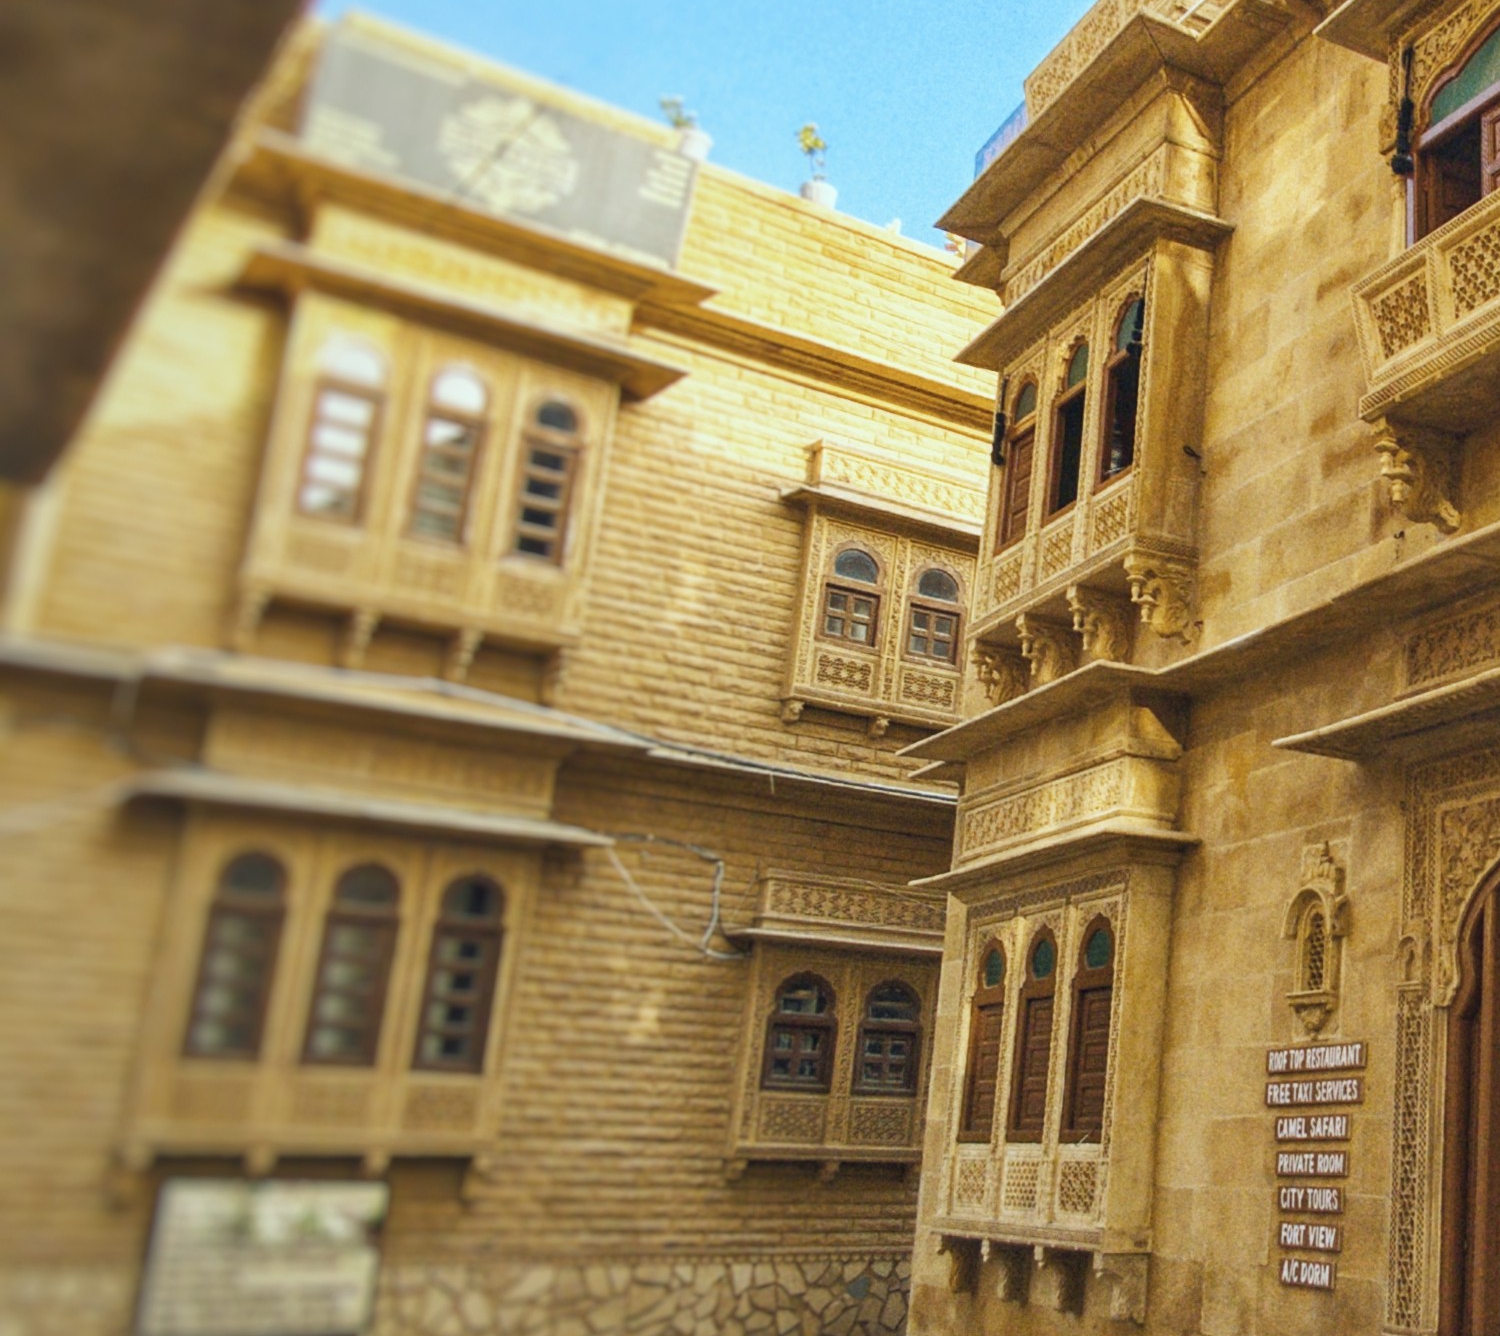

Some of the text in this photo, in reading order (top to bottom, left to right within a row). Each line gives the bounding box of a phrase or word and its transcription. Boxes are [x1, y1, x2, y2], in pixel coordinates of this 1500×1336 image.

[1268, 1043, 1361, 1071] ROOF TOP RESTAURANT
[1267, 1079, 1358, 1104] FREE TAXI SERVICES
[1277, 1116, 1346, 1138] CAMEL SAFARI
[1278, 1153, 1344, 1173] PRIVATE ROOM
[1281, 1187, 1338, 1210] CITY TOURS
[1281, 1223, 1336, 1248] FORT VIEW
[1281, 1258, 1330, 1286] A/C DORM
